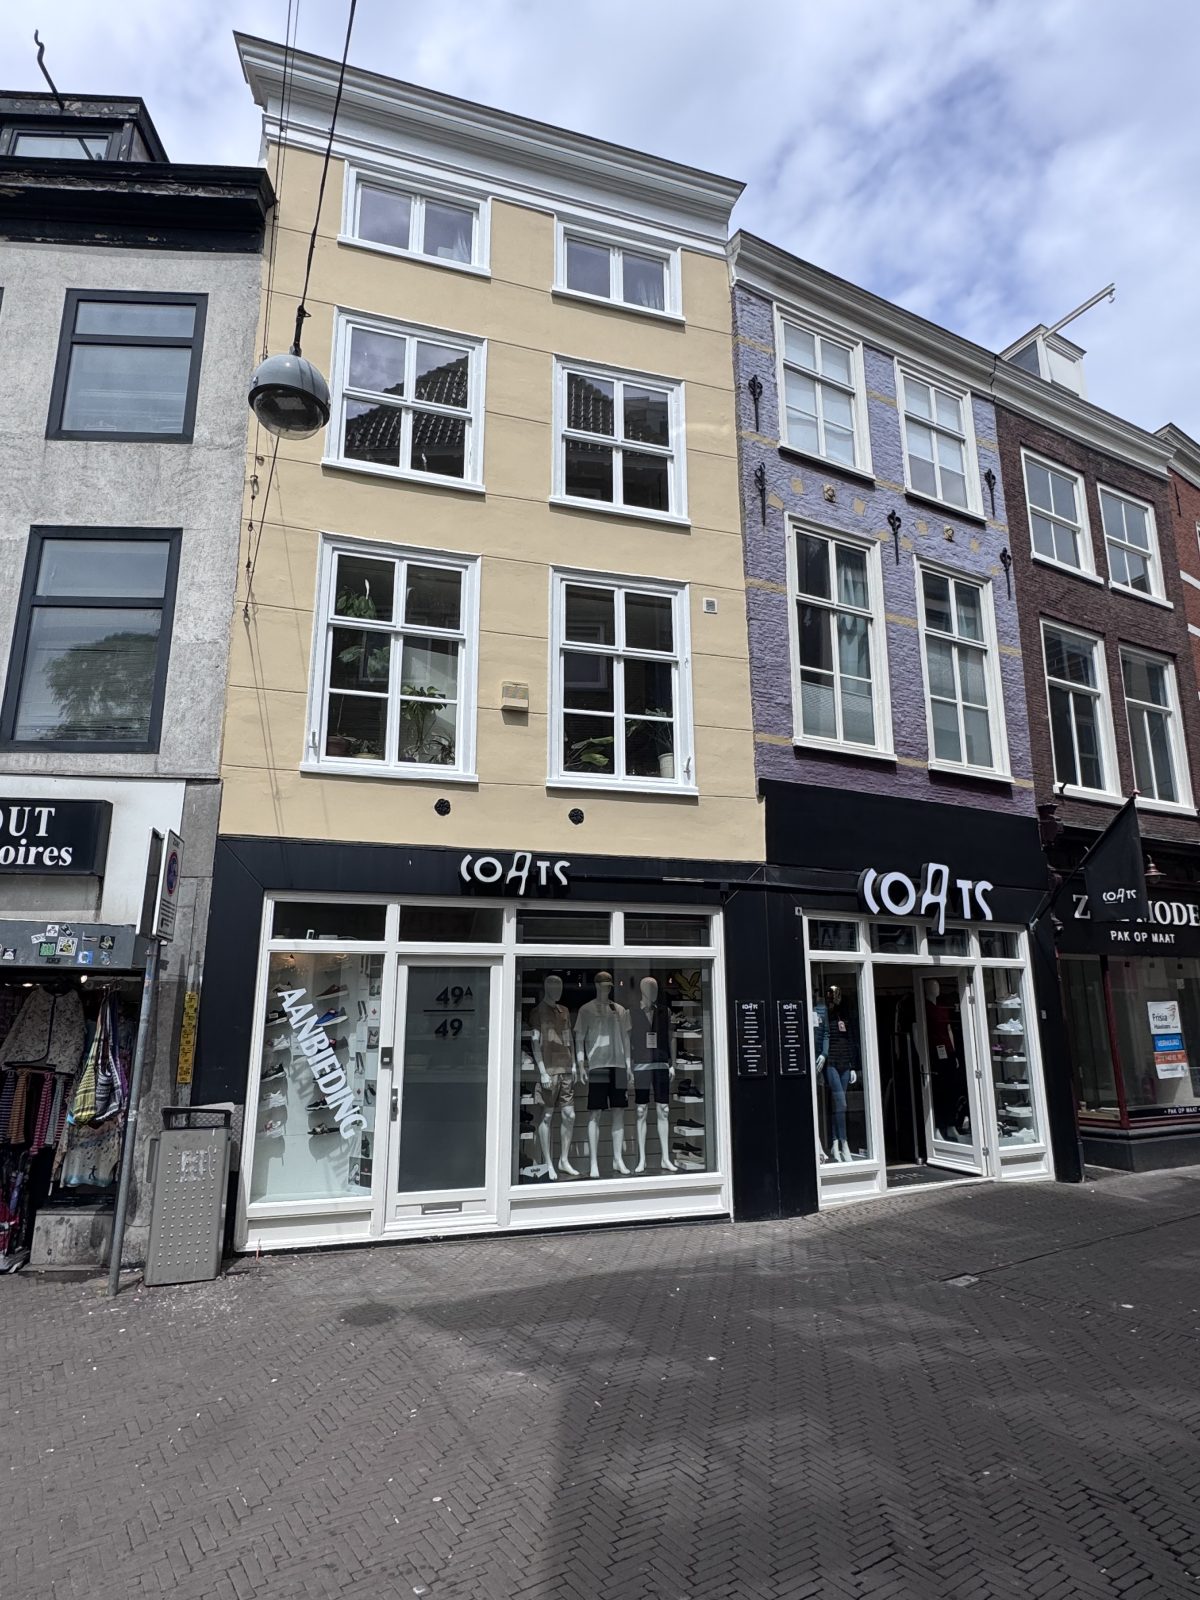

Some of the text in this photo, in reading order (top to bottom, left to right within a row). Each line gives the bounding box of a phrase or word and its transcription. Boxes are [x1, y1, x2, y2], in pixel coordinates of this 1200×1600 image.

[0, 806, 56, 837] UT
[0, 838, 73, 866] oires
[460, 851, 571, 896] COATS
[862, 861, 994, 936] COATS
[1110, 930, 1176, 944] PAK OP MAAT
[434, 1018, 464, 1038] 49
[277, 987, 368, 1140] AANBIEDING
